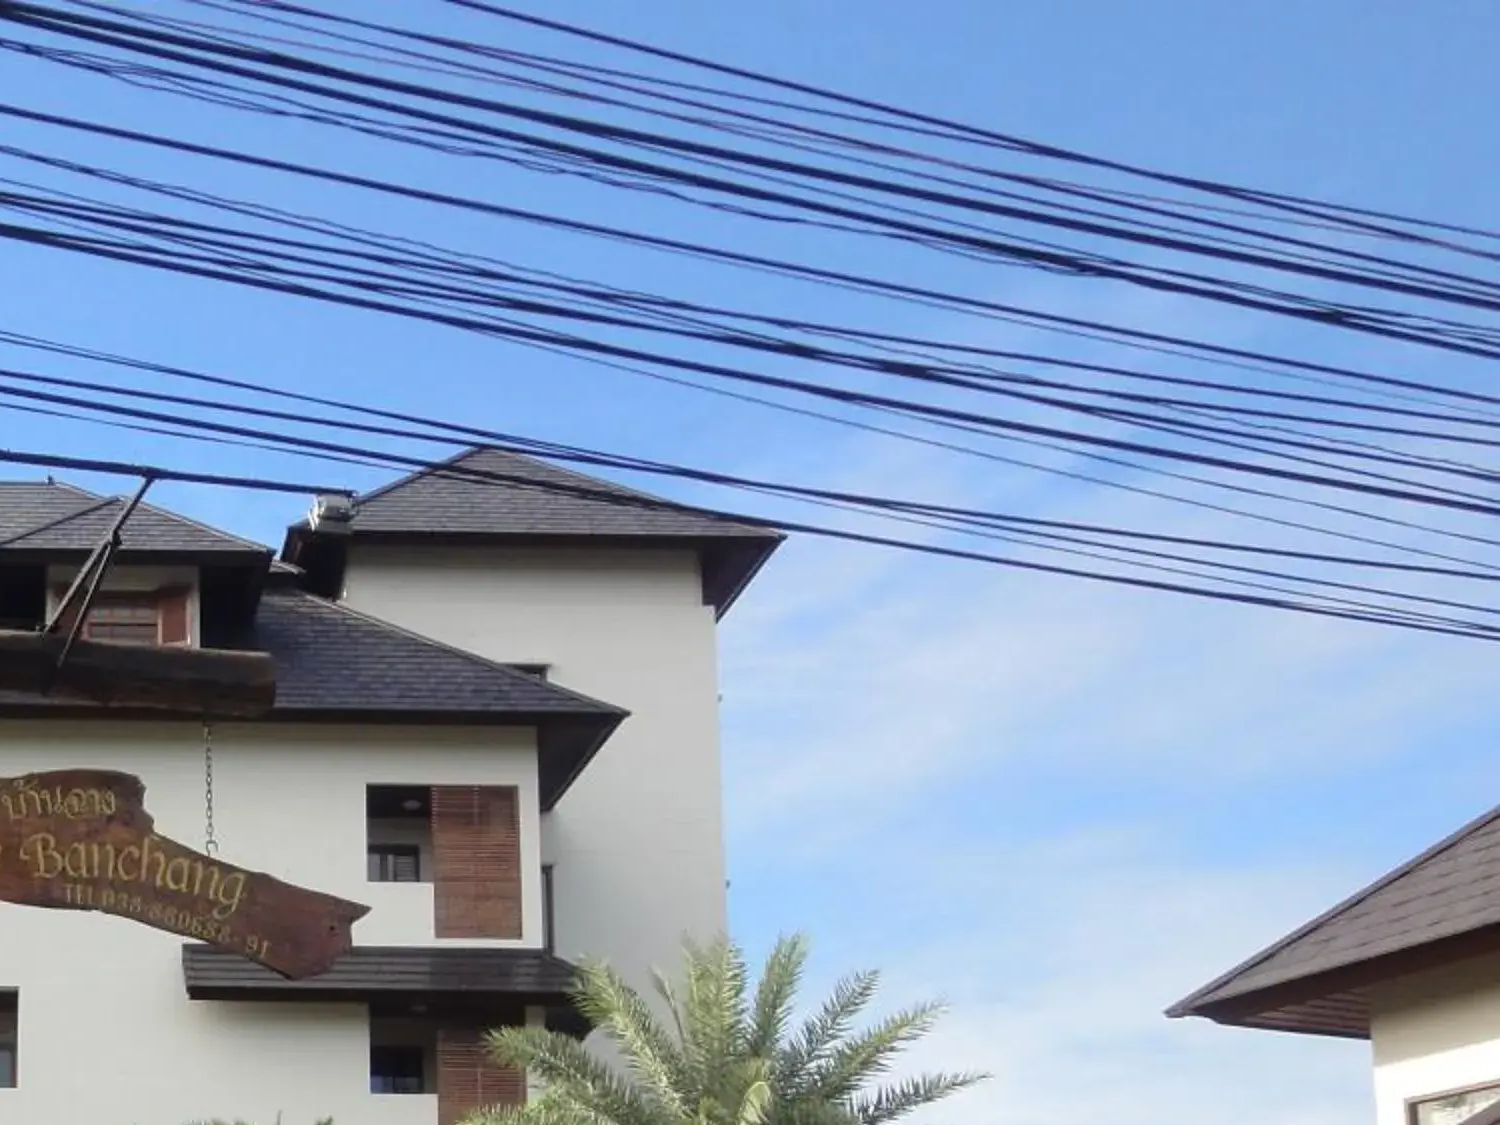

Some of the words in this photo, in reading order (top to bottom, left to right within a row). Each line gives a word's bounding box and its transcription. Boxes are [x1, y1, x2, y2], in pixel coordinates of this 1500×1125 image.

[1, 779, 117, 820] บ้านฉาง
[19, 831, 247, 920] Banchang
